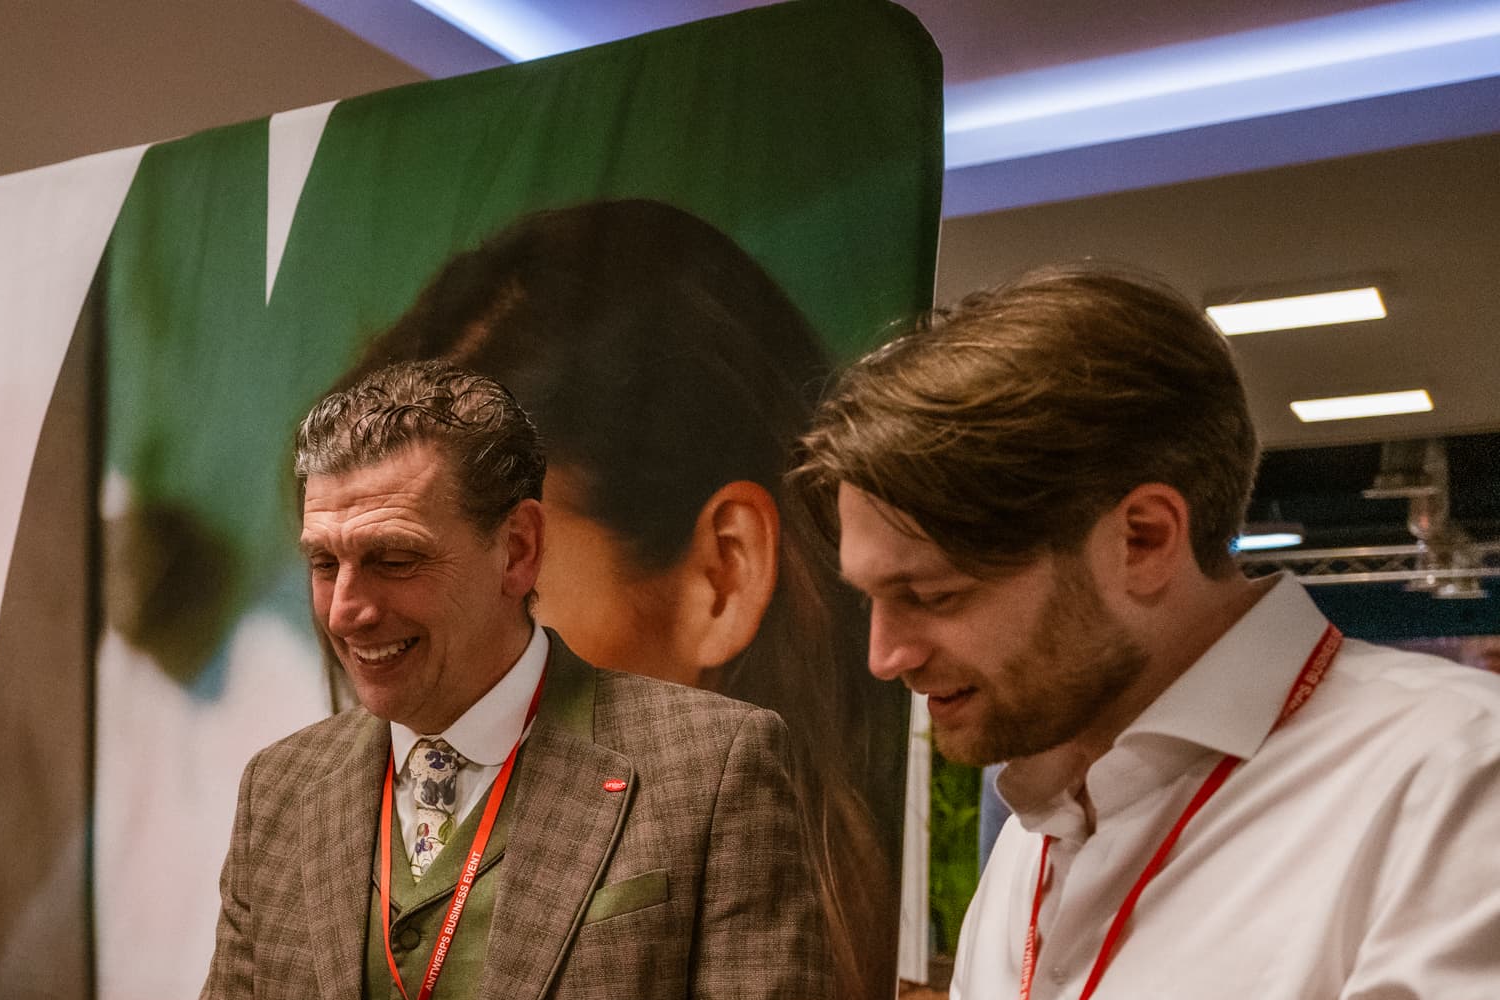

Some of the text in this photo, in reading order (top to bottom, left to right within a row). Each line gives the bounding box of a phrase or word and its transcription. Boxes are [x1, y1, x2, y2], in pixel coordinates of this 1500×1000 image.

[425, 852, 482, 991] ANTWERPS BUSINESS EVENT
